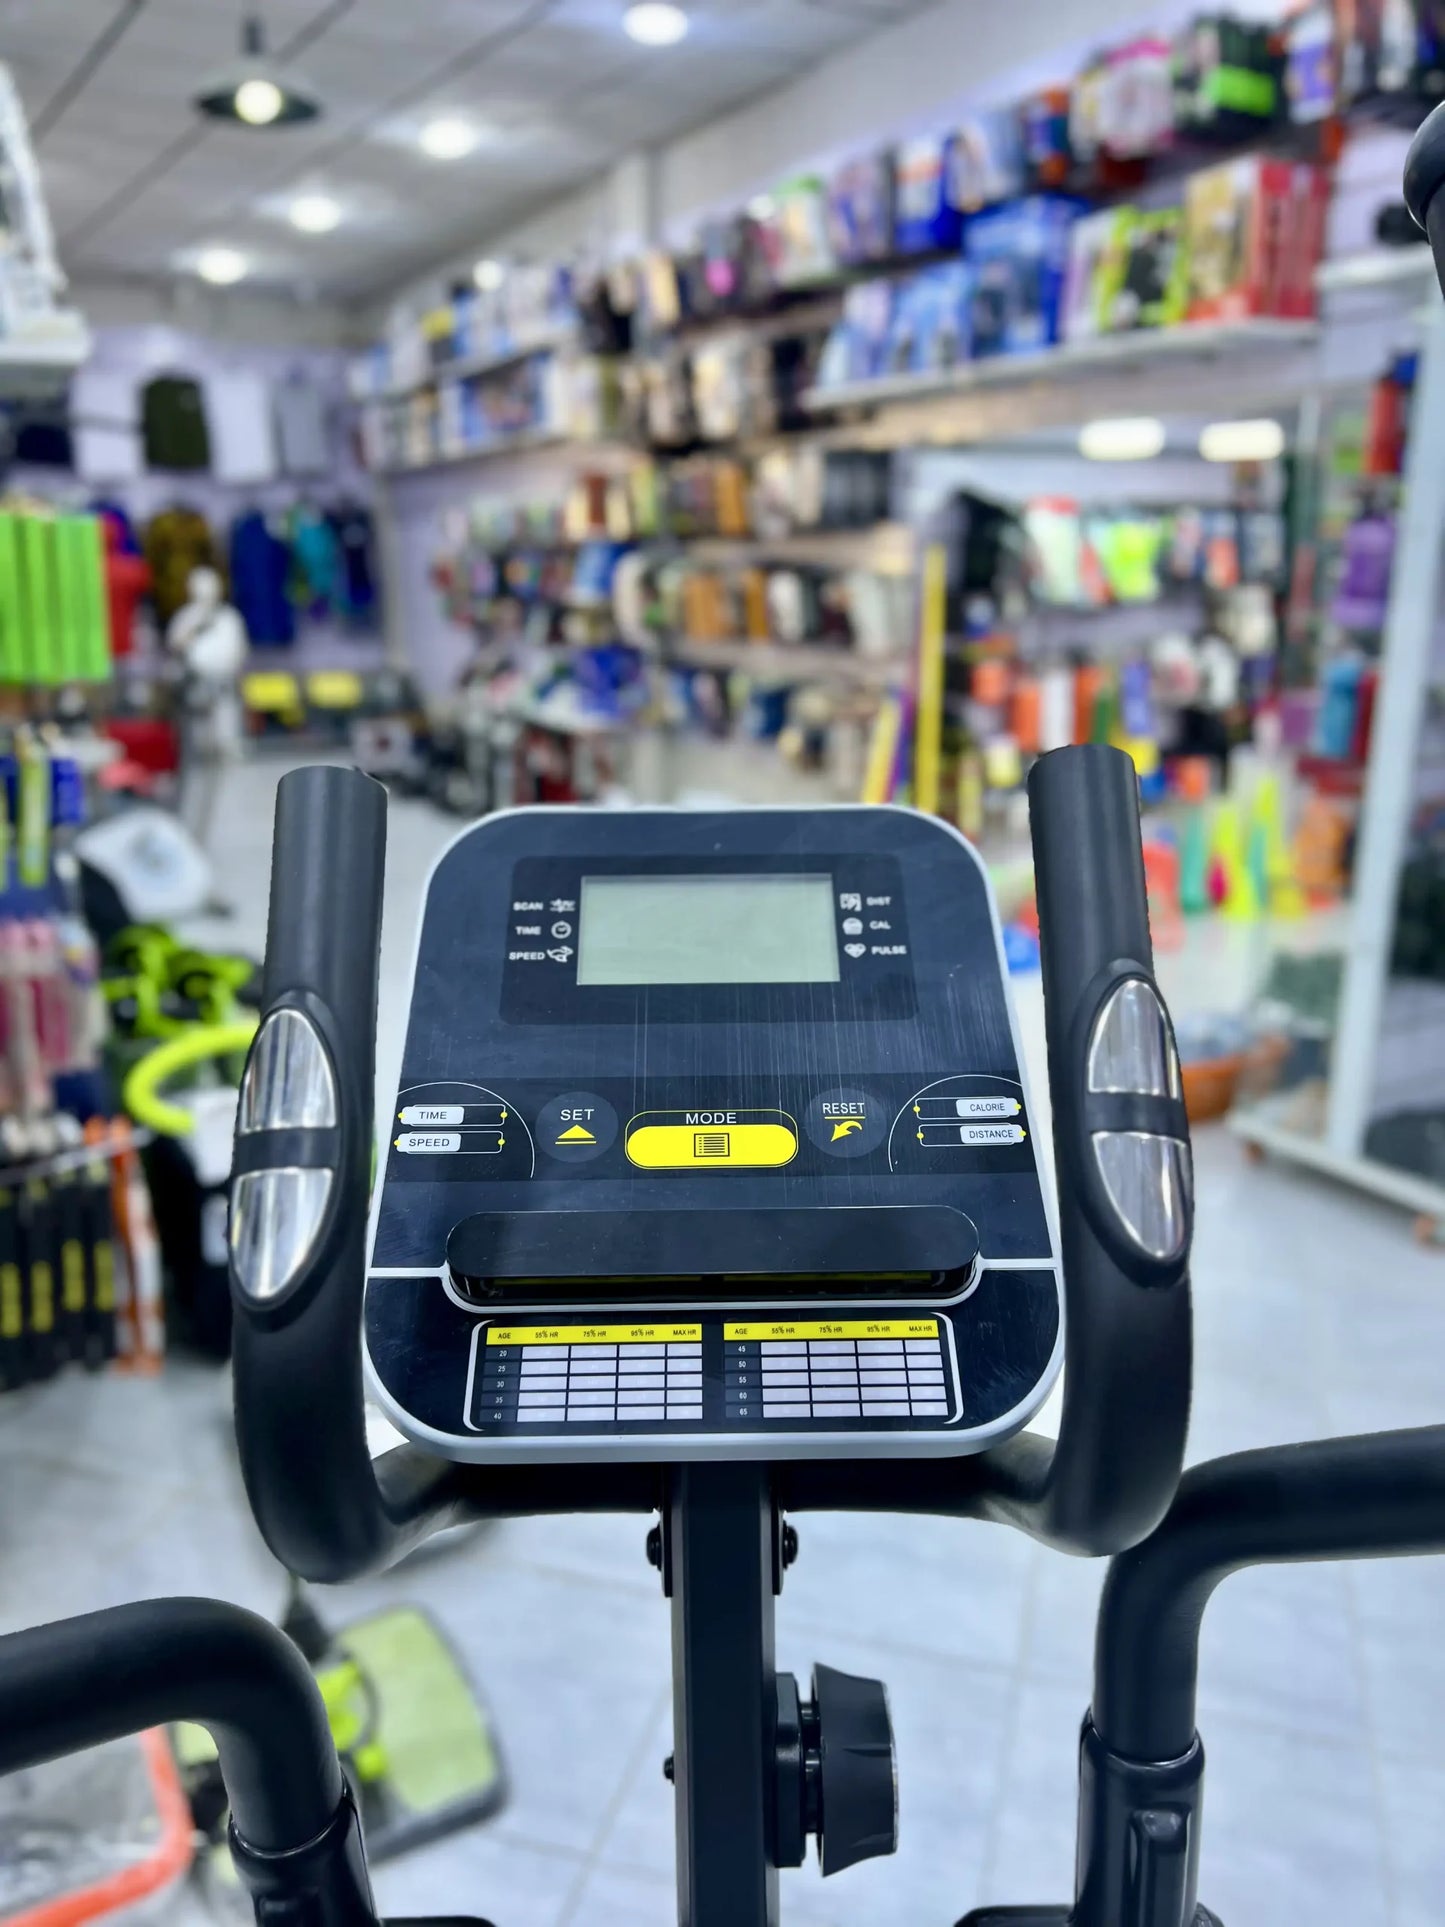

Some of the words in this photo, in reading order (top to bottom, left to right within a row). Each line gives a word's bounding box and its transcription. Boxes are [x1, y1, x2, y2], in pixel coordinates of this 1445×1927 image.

[866, 896, 891, 906] DIST
[513, 902, 543, 910] SCAN
[870, 920, 892, 930] CAL
[515, 926, 541, 935] TIME
[872, 946, 908, 954] PULSE
[509, 952, 545, 960] SPEED
[823, 1103, 865, 1114] RESET
[970, 1103, 1005, 1112] CALORIE
[419, 1111, 448, 1120] TIME
[560, 1109, 594, 1121] SET
[686, 1113, 738, 1124] MODE
[969, 1130, 1014, 1139] DISTANCE
[409, 1138, 450, 1147] SPEED
[631, 1329, 643, 1337] 95%
[819, 1326, 832, 1334] 75%
